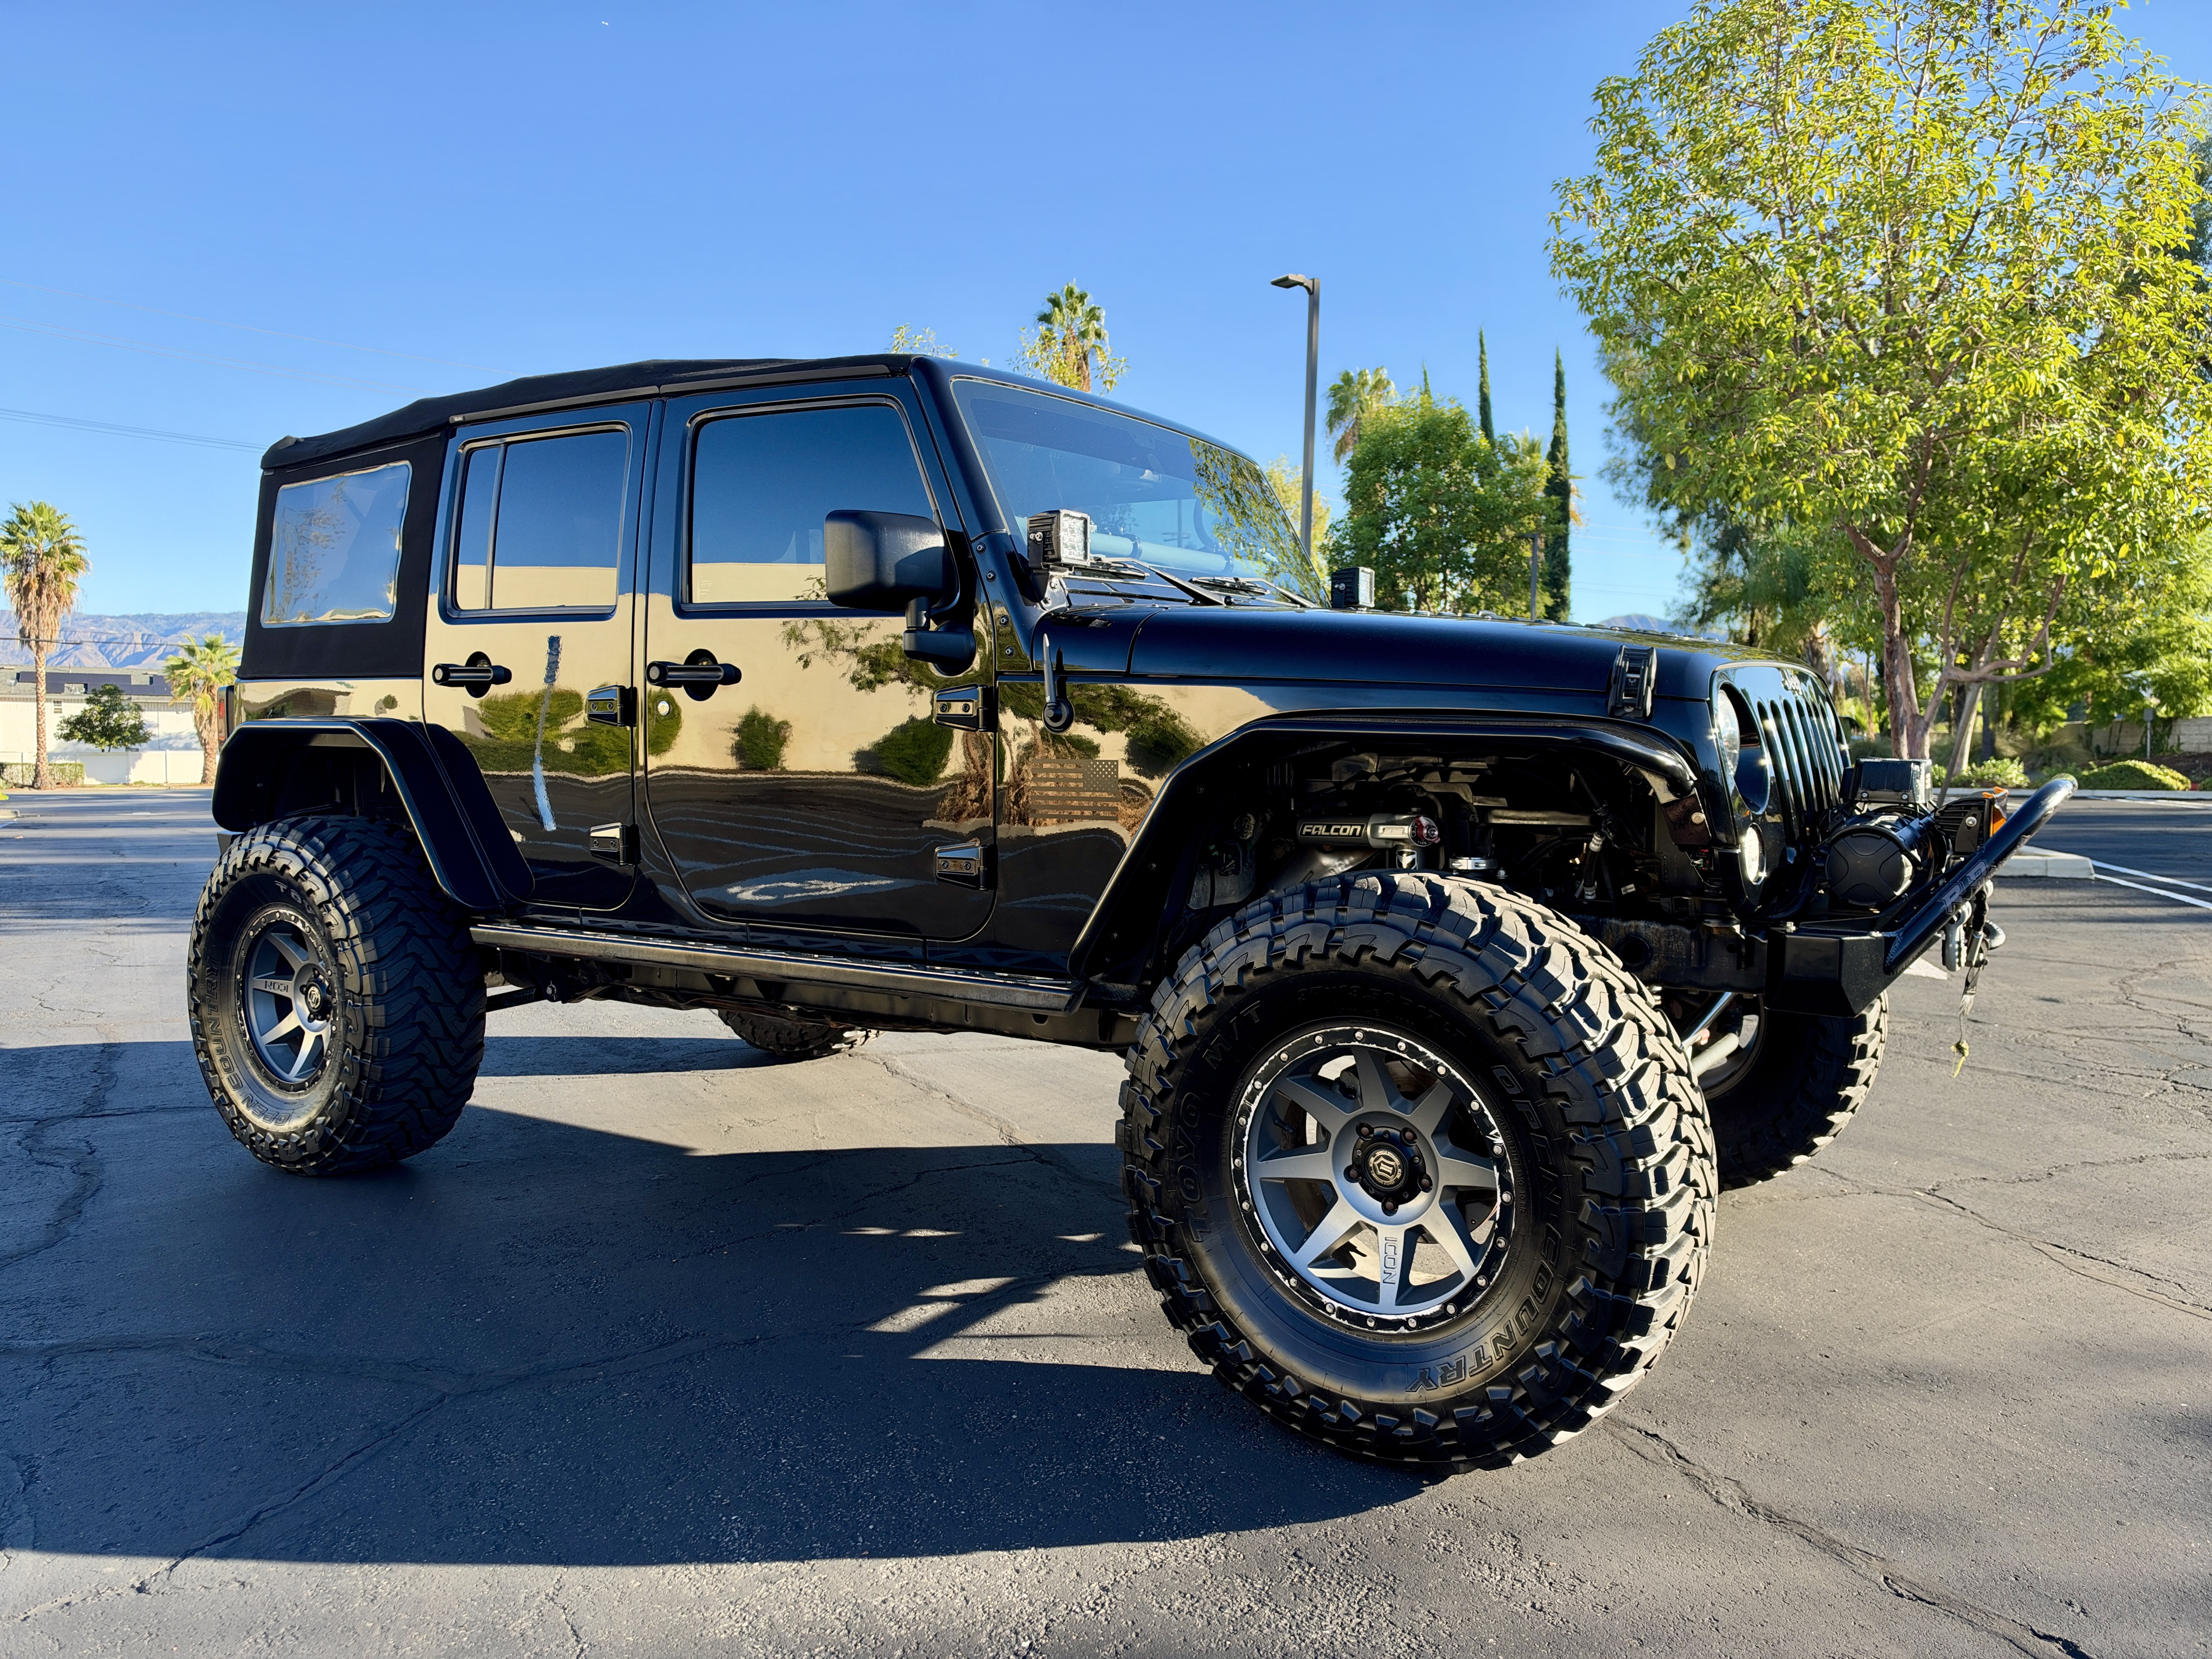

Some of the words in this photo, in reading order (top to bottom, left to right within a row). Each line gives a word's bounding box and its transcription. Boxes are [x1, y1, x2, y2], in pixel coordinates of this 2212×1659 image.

[1302, 825, 1361, 836] FALCON
[264, 981, 289, 993] ICON
[205, 956, 243, 1092] COUNTRY
[1202, 1000, 1261, 1070] M/T
[241, 1094, 290, 1126] OPEN
[1177, 1092, 1211, 1242] TOYO
[1383, 1237, 1397, 1284] ICON
[1405, 1223, 1561, 1392] COUNTRY
